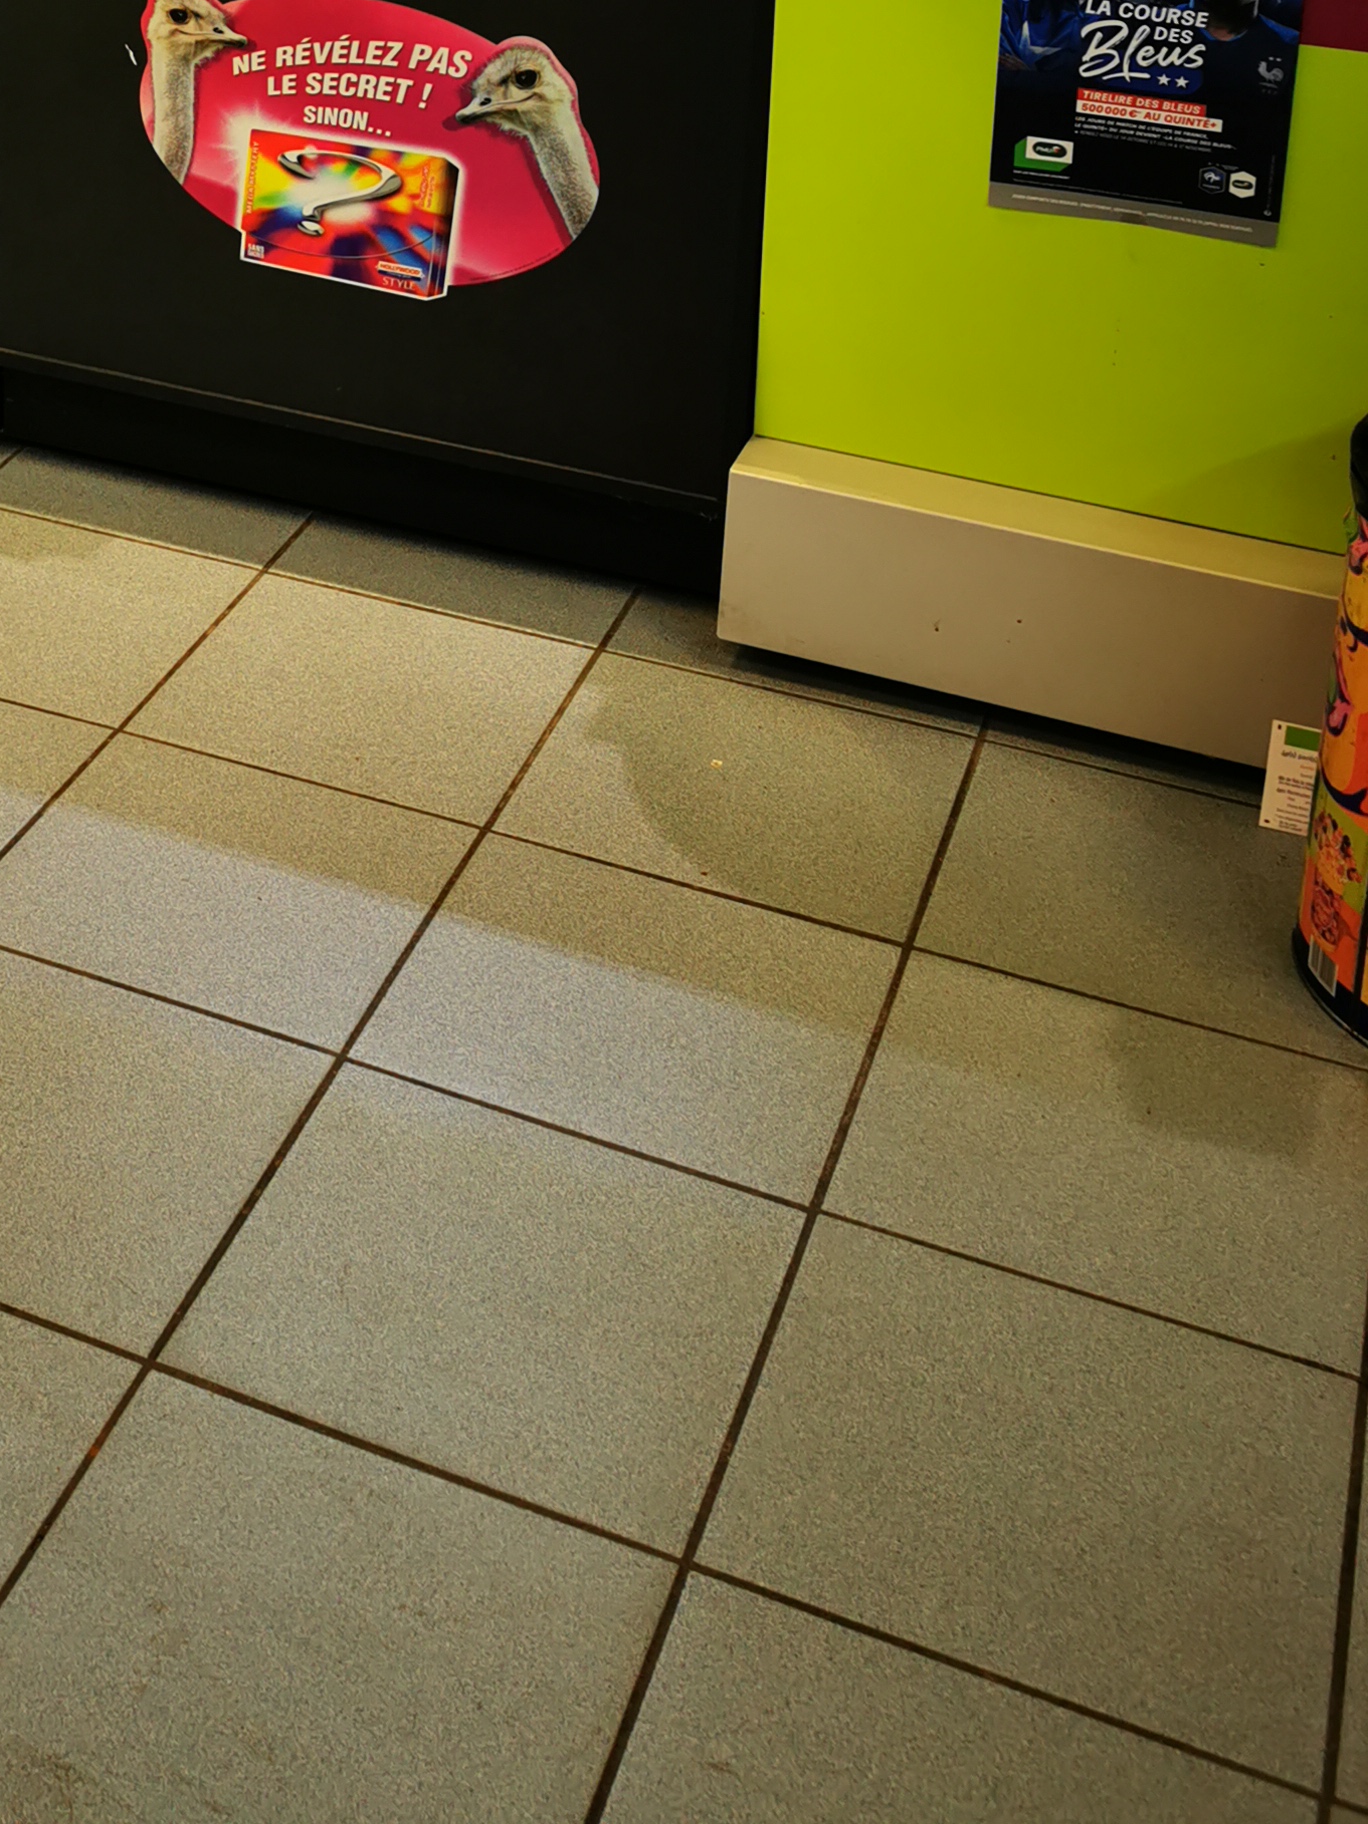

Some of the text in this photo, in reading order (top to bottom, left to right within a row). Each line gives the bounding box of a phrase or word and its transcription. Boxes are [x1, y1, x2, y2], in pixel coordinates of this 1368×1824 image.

[1118, 0, 1210, 30] COURSE
[1078, 18, 1206, 84] Bleus
[1153, 24, 1194, 48] DES
[232, 34, 473, 80] NE RÉVÉLEZ PAS
[267, 72, 433, 111] LE SECRET !
[1082, 89, 1201, 116] TIRELIRE DES BLEUS
[303, 104, 392, 137] SINON...
[1144, 110, 1161, 122] AU
[1163, 112, 1218, 130] QUINTÉ+
[382, 276, 416, 291] STYLE
